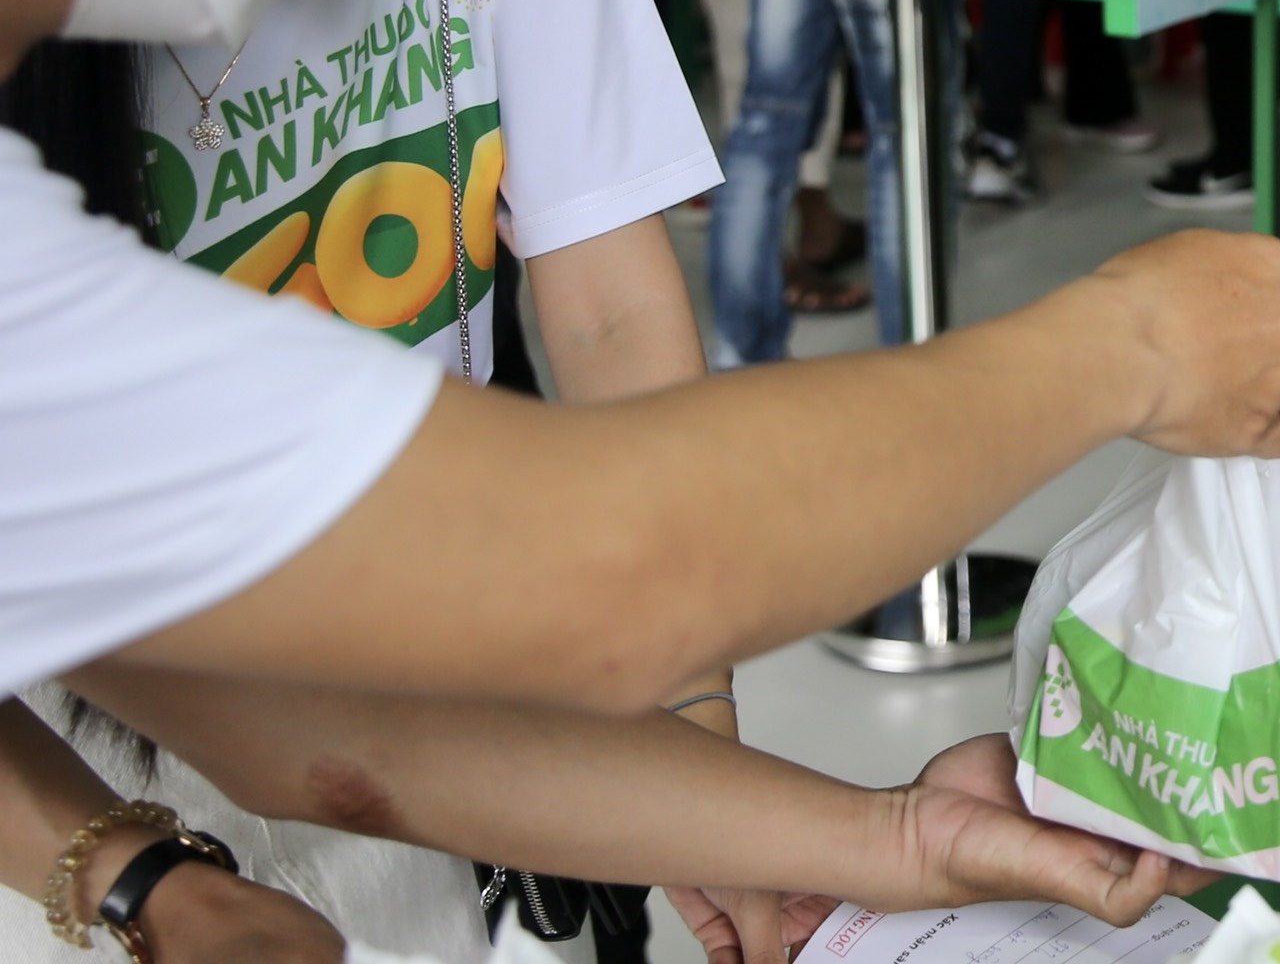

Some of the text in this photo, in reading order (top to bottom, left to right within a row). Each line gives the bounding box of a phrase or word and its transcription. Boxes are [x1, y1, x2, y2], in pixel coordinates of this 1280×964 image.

[204, 16, 475, 223] AN KHANG
[220, 59, 328, 140] NHÀ
[1081, 721, 1280, 819] AN KHANG
[1113, 709, 1217, 768] NHÀ THU
[937, 912, 959, 930] Xác
